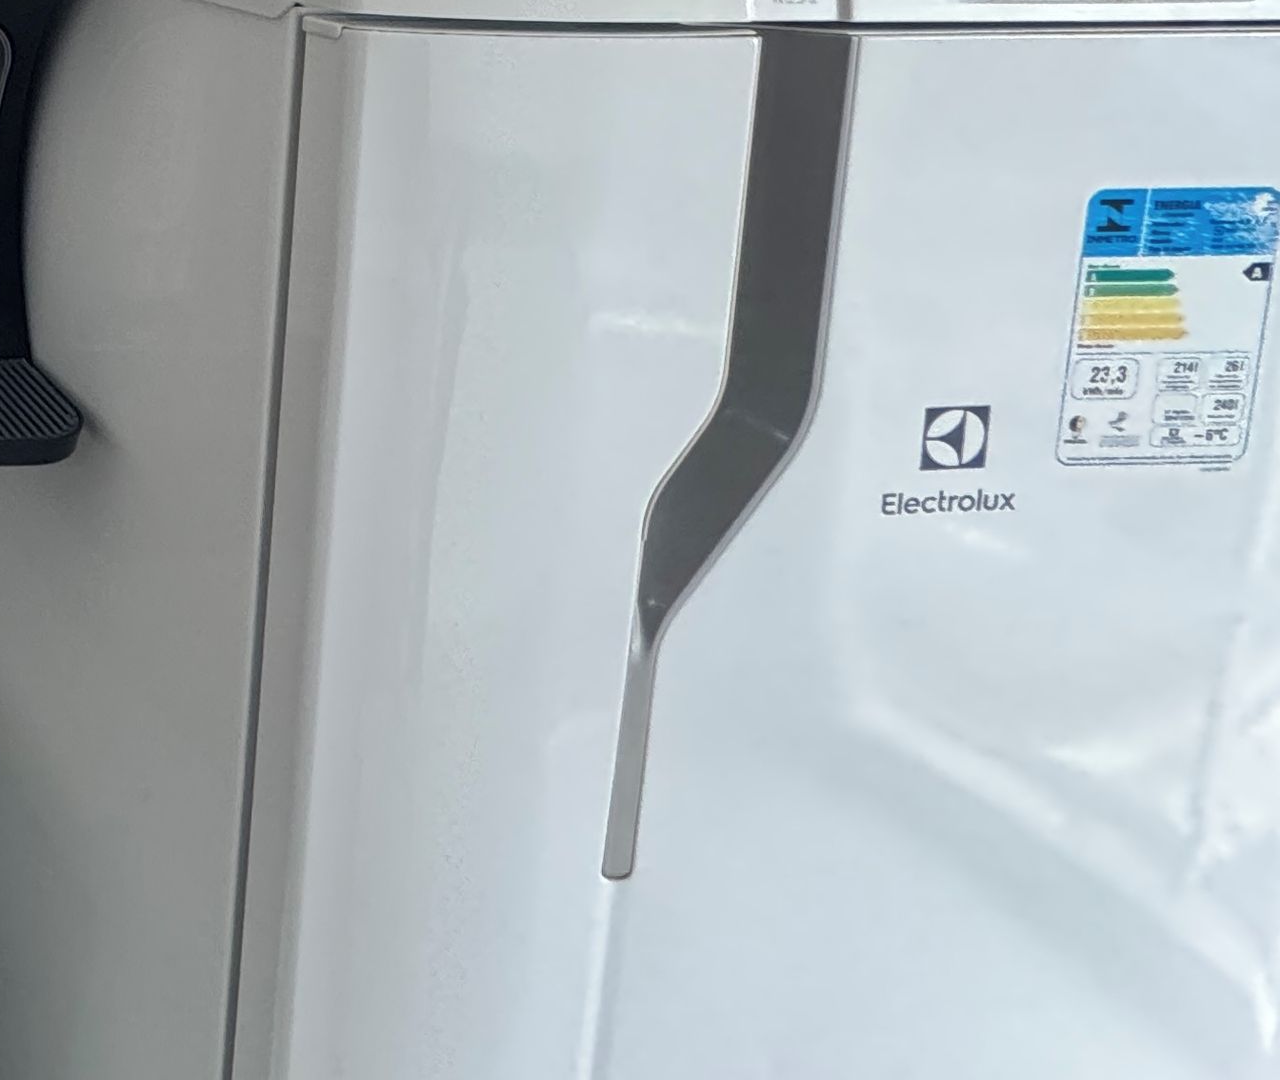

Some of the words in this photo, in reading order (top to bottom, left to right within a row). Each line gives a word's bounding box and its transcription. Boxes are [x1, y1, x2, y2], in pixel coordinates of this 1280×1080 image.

[1252, 267, 1262, 279] A
[1089, 366, 1128, 384] 23,3
[881, 488, 1016, 516] Electrolux
